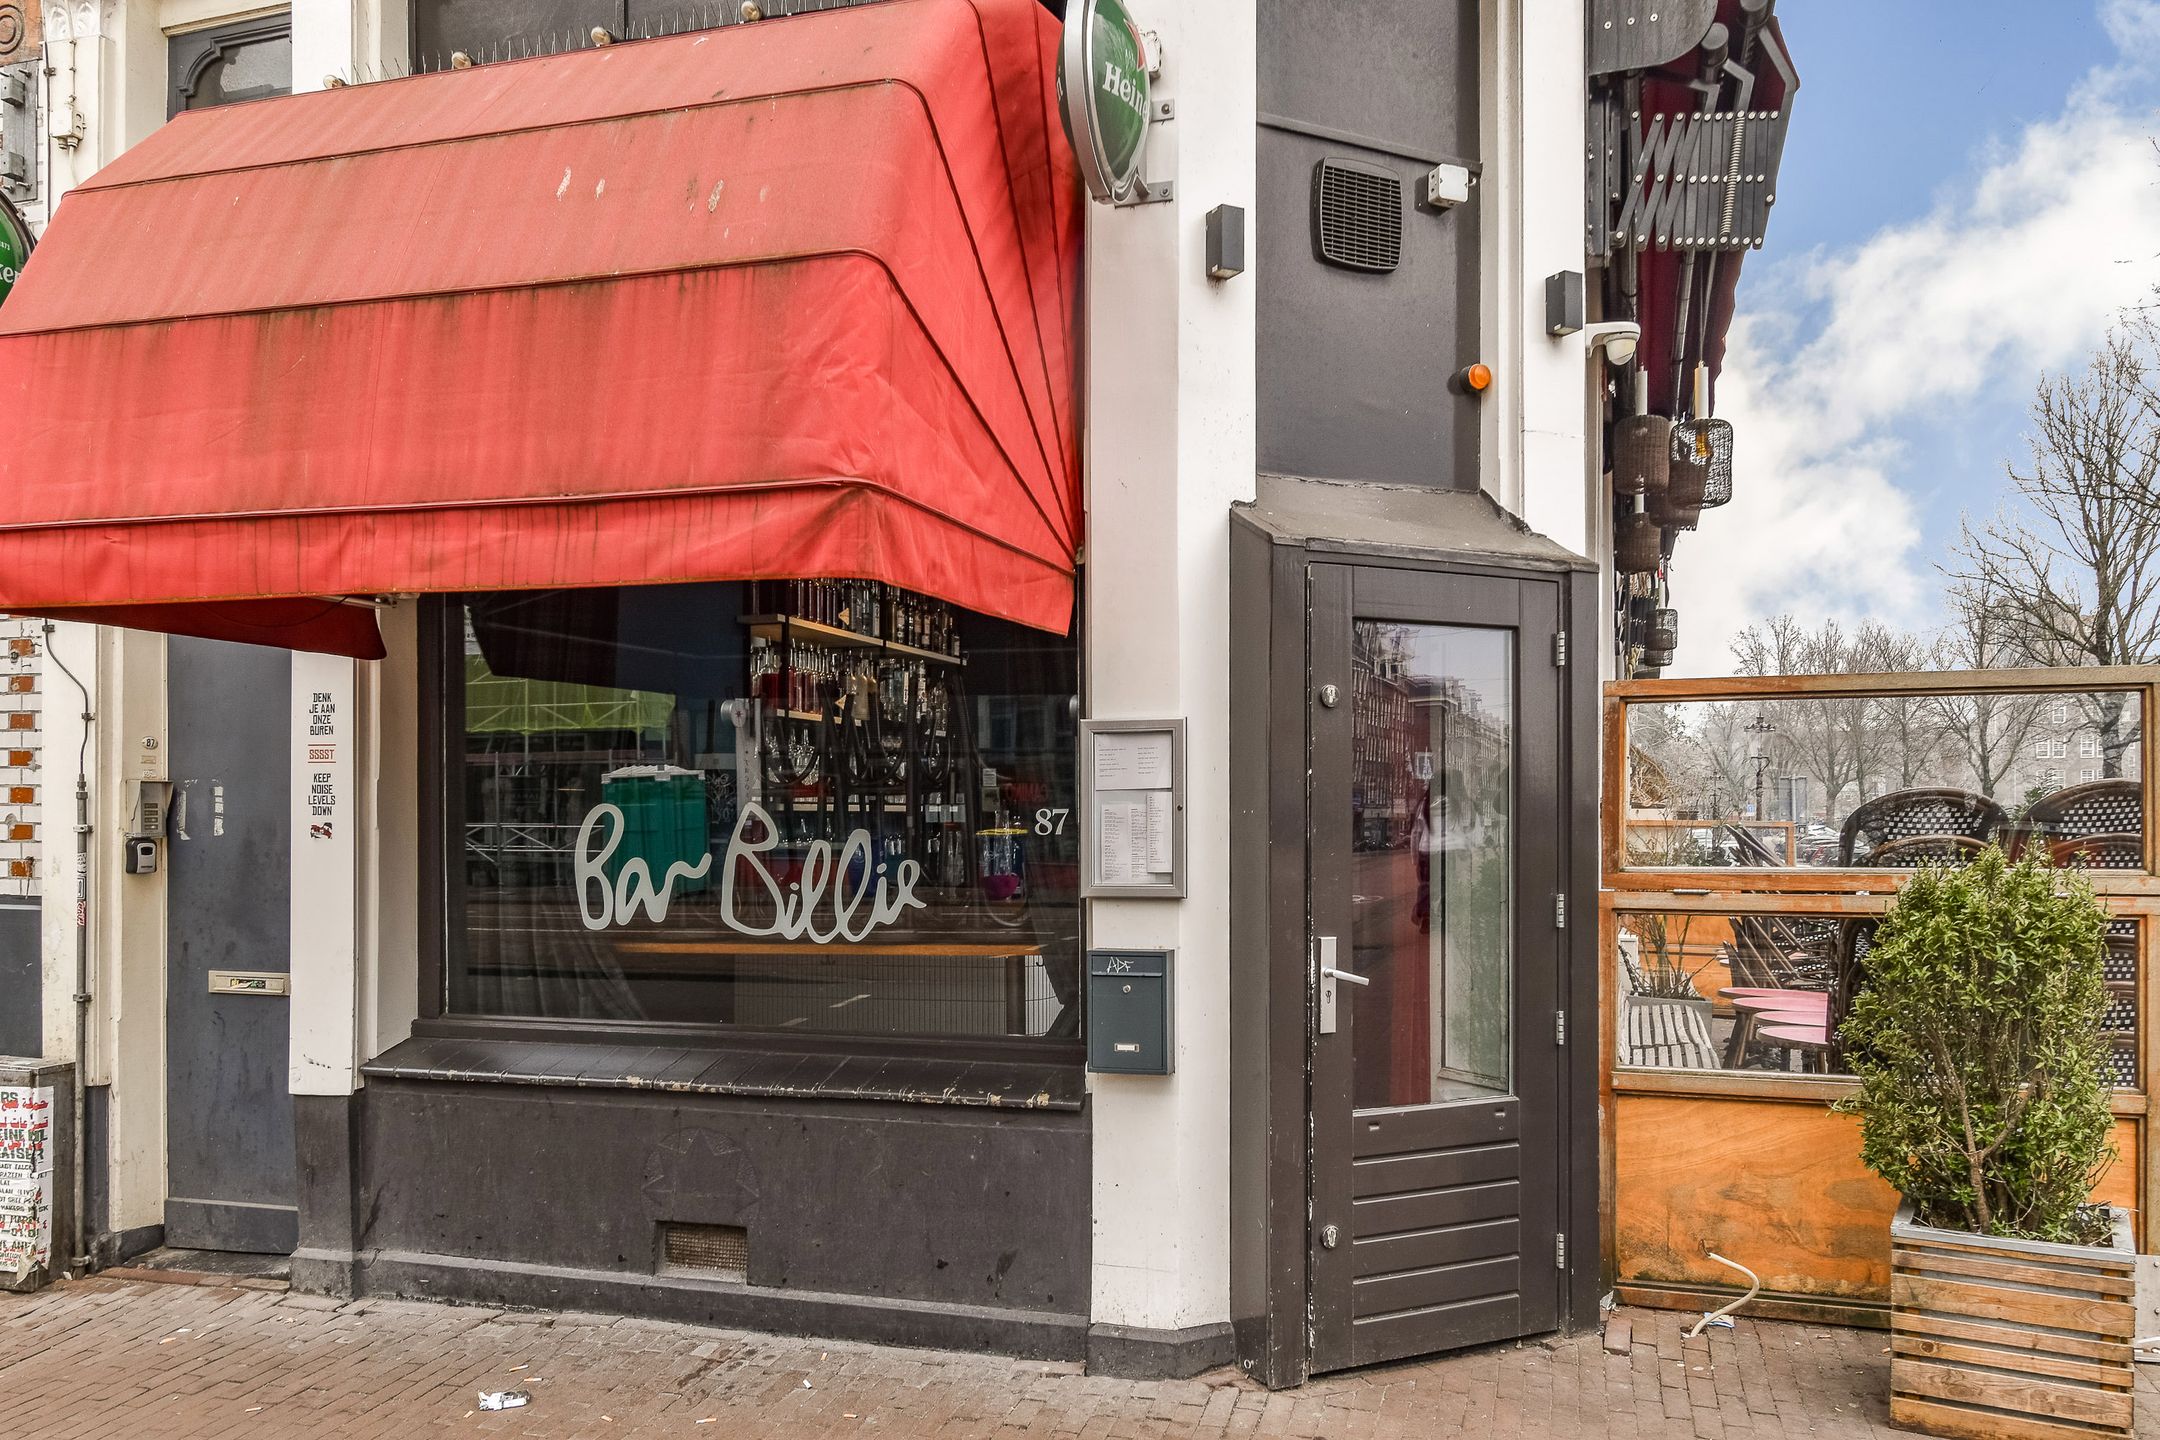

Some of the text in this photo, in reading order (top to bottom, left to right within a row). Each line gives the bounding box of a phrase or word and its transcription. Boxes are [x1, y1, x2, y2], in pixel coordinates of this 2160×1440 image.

[313, 693, 332, 703] DENK
[309, 704, 335, 714] JE AAN
[313, 715, 331, 725] ONZE
[310, 725, 334, 736] BUREN
[146, 738, 155, 748] 87
[309, 749, 335, 760] SSSST
[313, 773, 331, 783] KEEP
[311, 784, 333, 795] NOISE
[308, 795, 336, 806] LEVELS
[312, 806, 332, 816] DOWN
[1034, 808, 1070, 836] 87
[574, 802, 927, 944] Bar Billie
